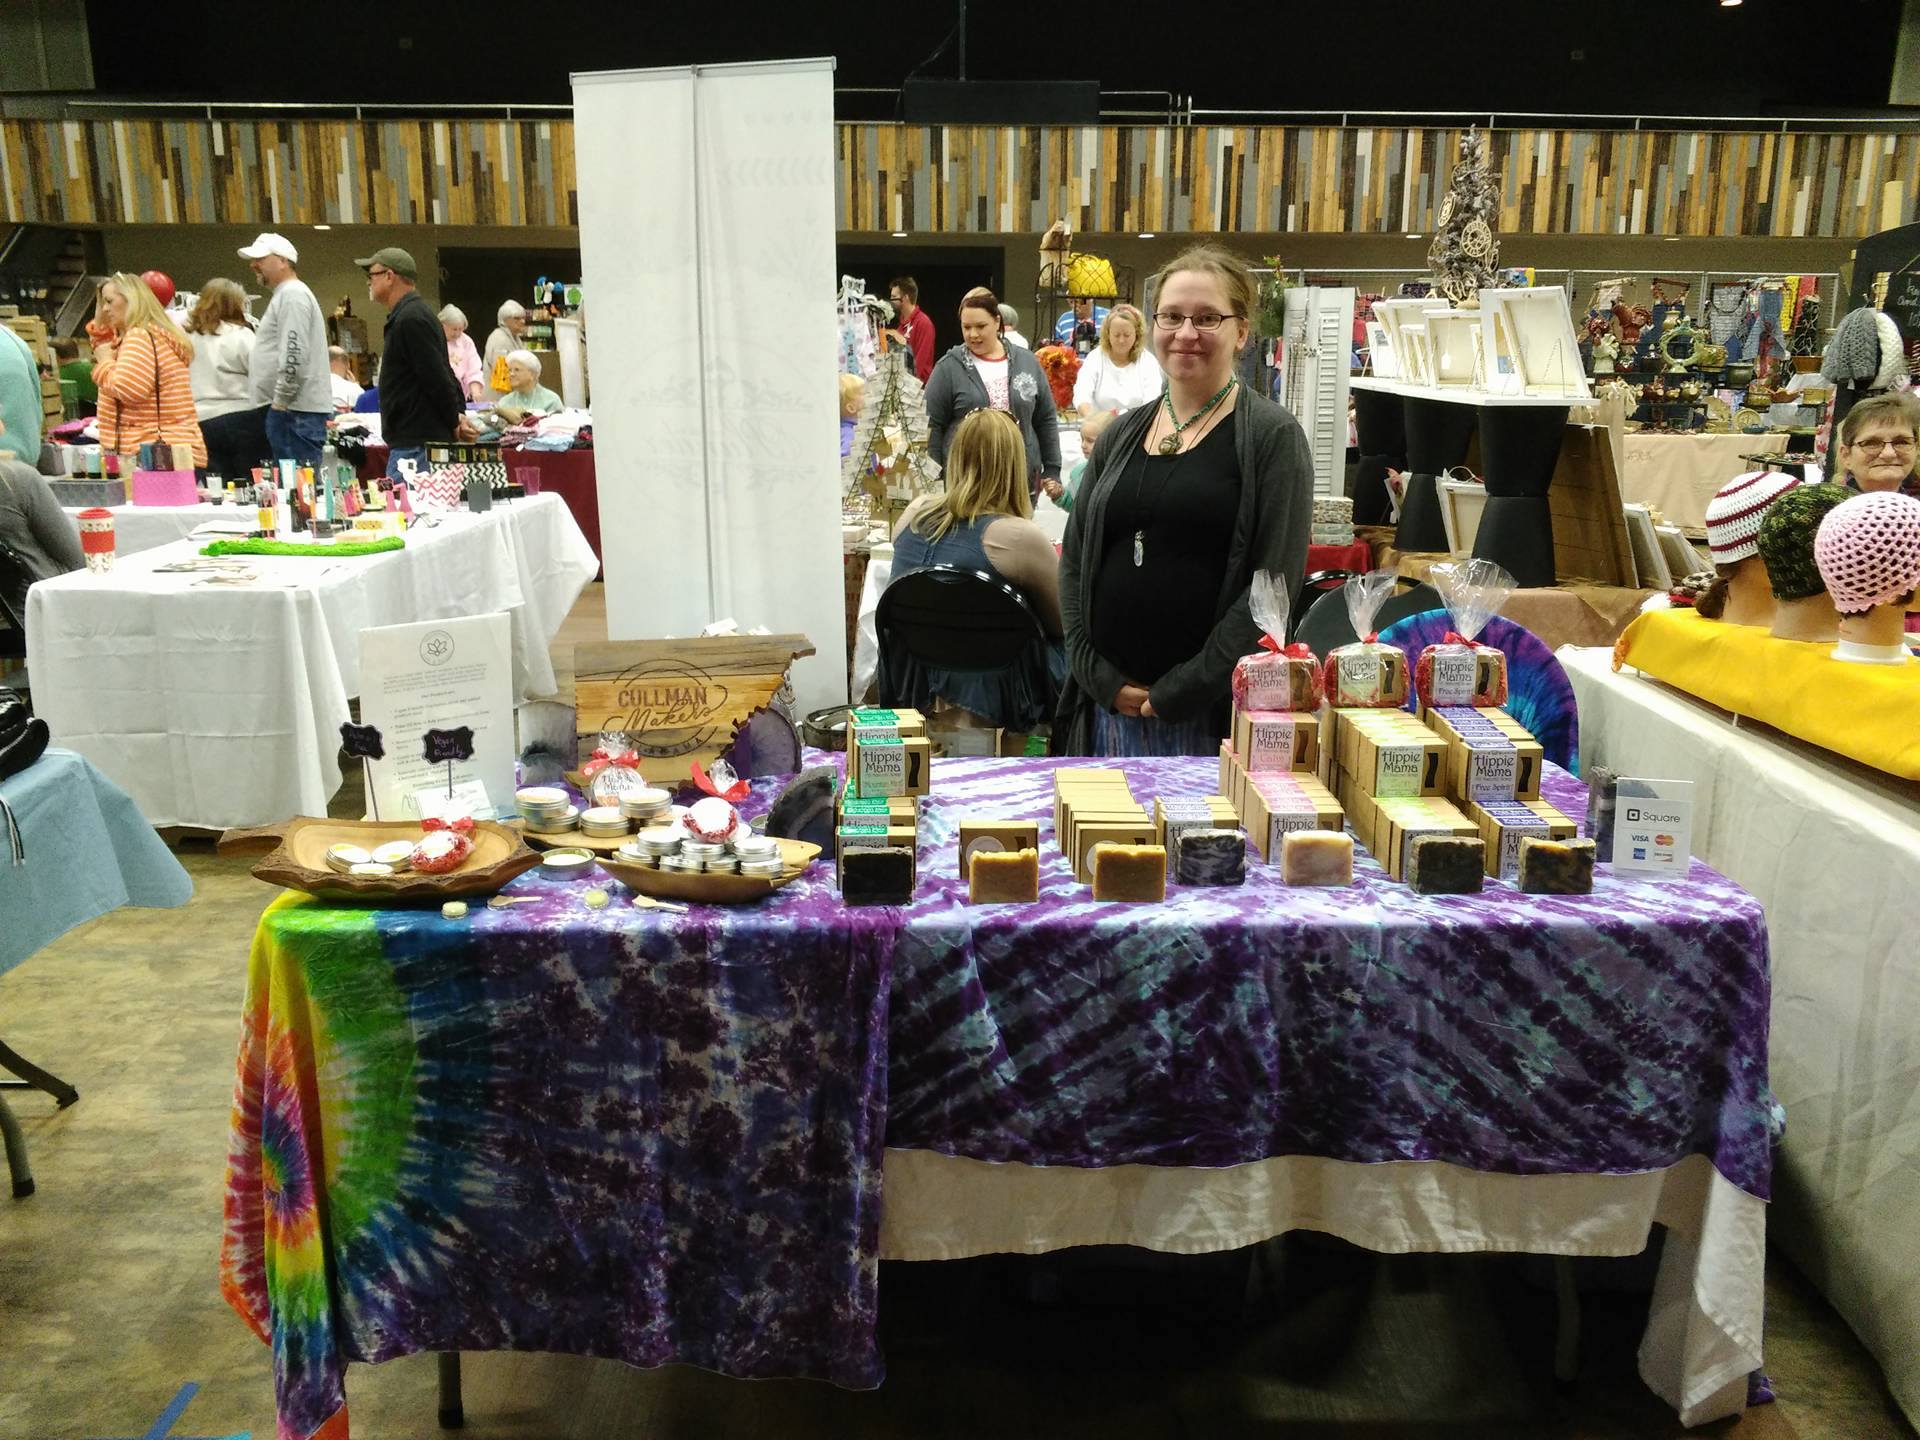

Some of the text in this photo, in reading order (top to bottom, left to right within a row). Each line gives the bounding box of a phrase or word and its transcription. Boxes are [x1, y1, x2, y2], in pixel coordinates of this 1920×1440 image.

[1437, 661, 1474, 674] Hippie
[1250, 668, 1287, 680] Hippie
[1438, 671, 1472, 682] Mama
[618, 687, 708, 707] CULLMAN
[615, 694, 716, 737] Makers
[1256, 727, 1292, 740] Hippie
[1257, 738, 1290, 749] Mama
[862, 751, 903, 765] Hippie
[1381, 751, 1421, 764] Hippie
[1474, 755, 1514, 769] Hippie
[865, 762, 901, 773] Mama
[1383, 762, 1418, 773] Mama
[1475, 766, 1512, 777] Mama
[1642, 811, 1681, 823] Square
[1274, 818, 1315, 832] Hippie
[1632, 834, 1649, 843] VISA
